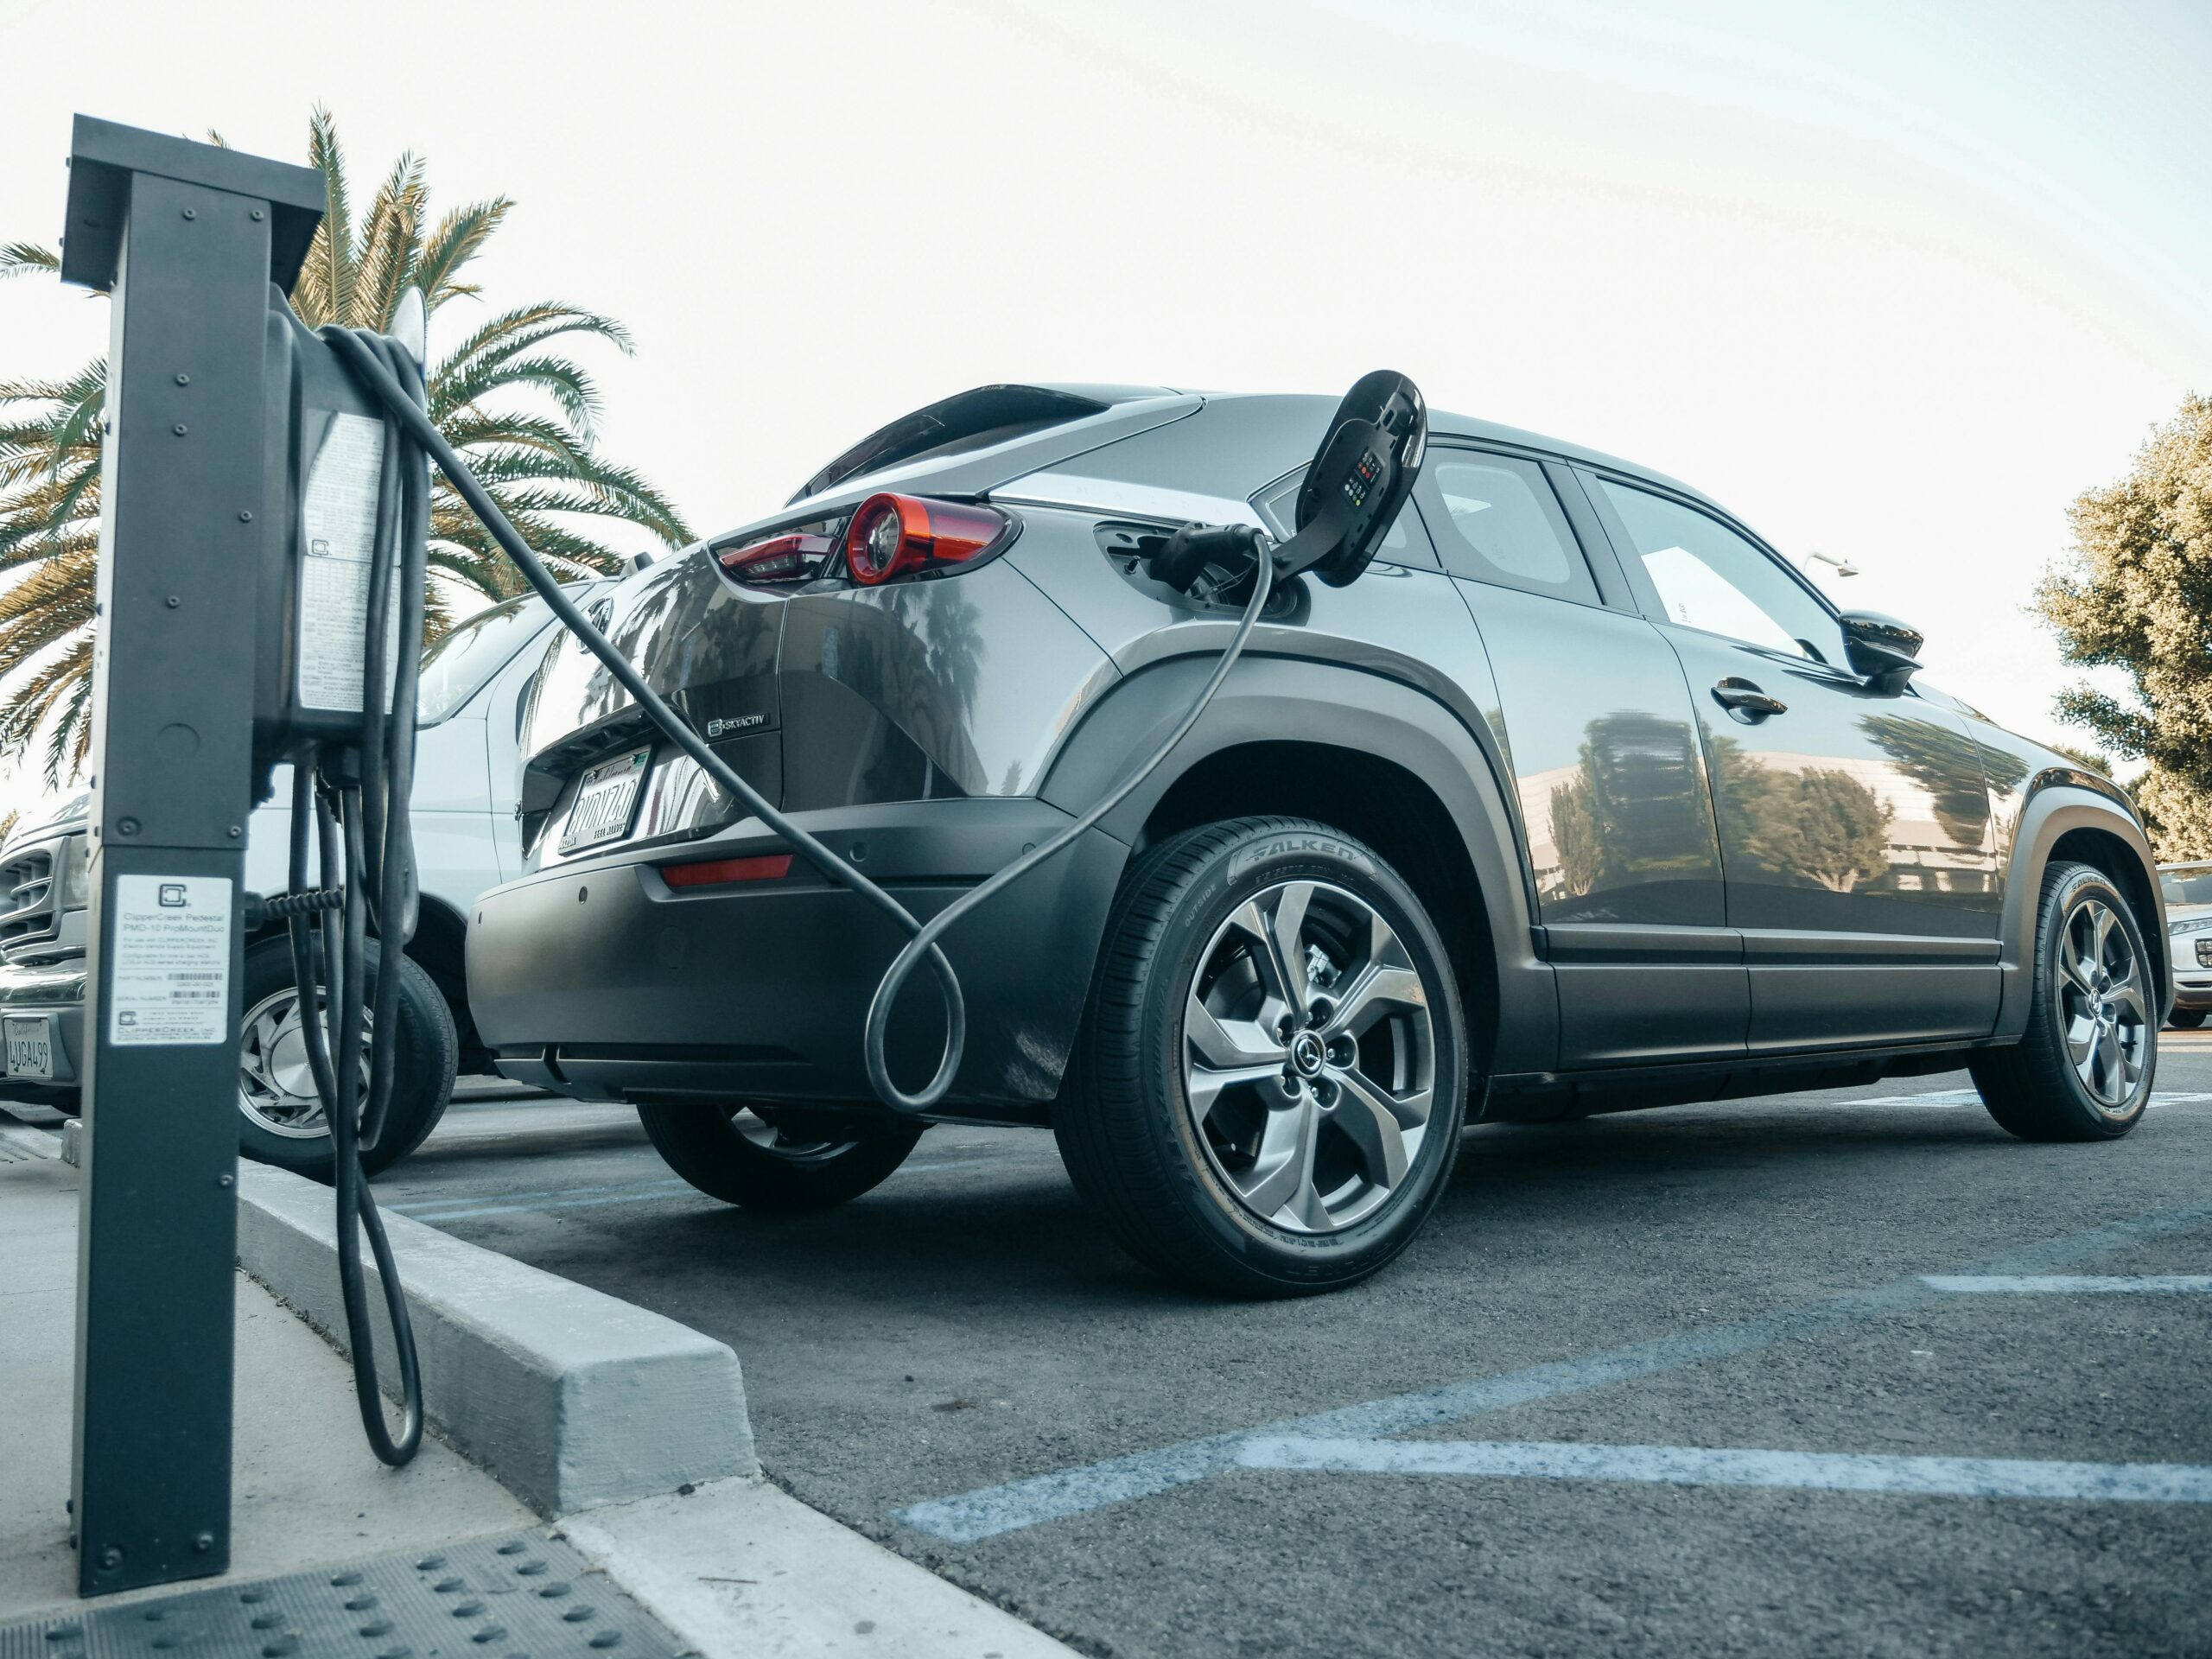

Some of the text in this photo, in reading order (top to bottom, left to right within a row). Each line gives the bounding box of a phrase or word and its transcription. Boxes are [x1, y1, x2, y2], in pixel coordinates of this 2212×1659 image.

[1246, 840, 1354, 861] FALKEN
[1185, 884, 1217, 927] OUTSIDE
[10, 1040, 48, 1069] 4UGA499
